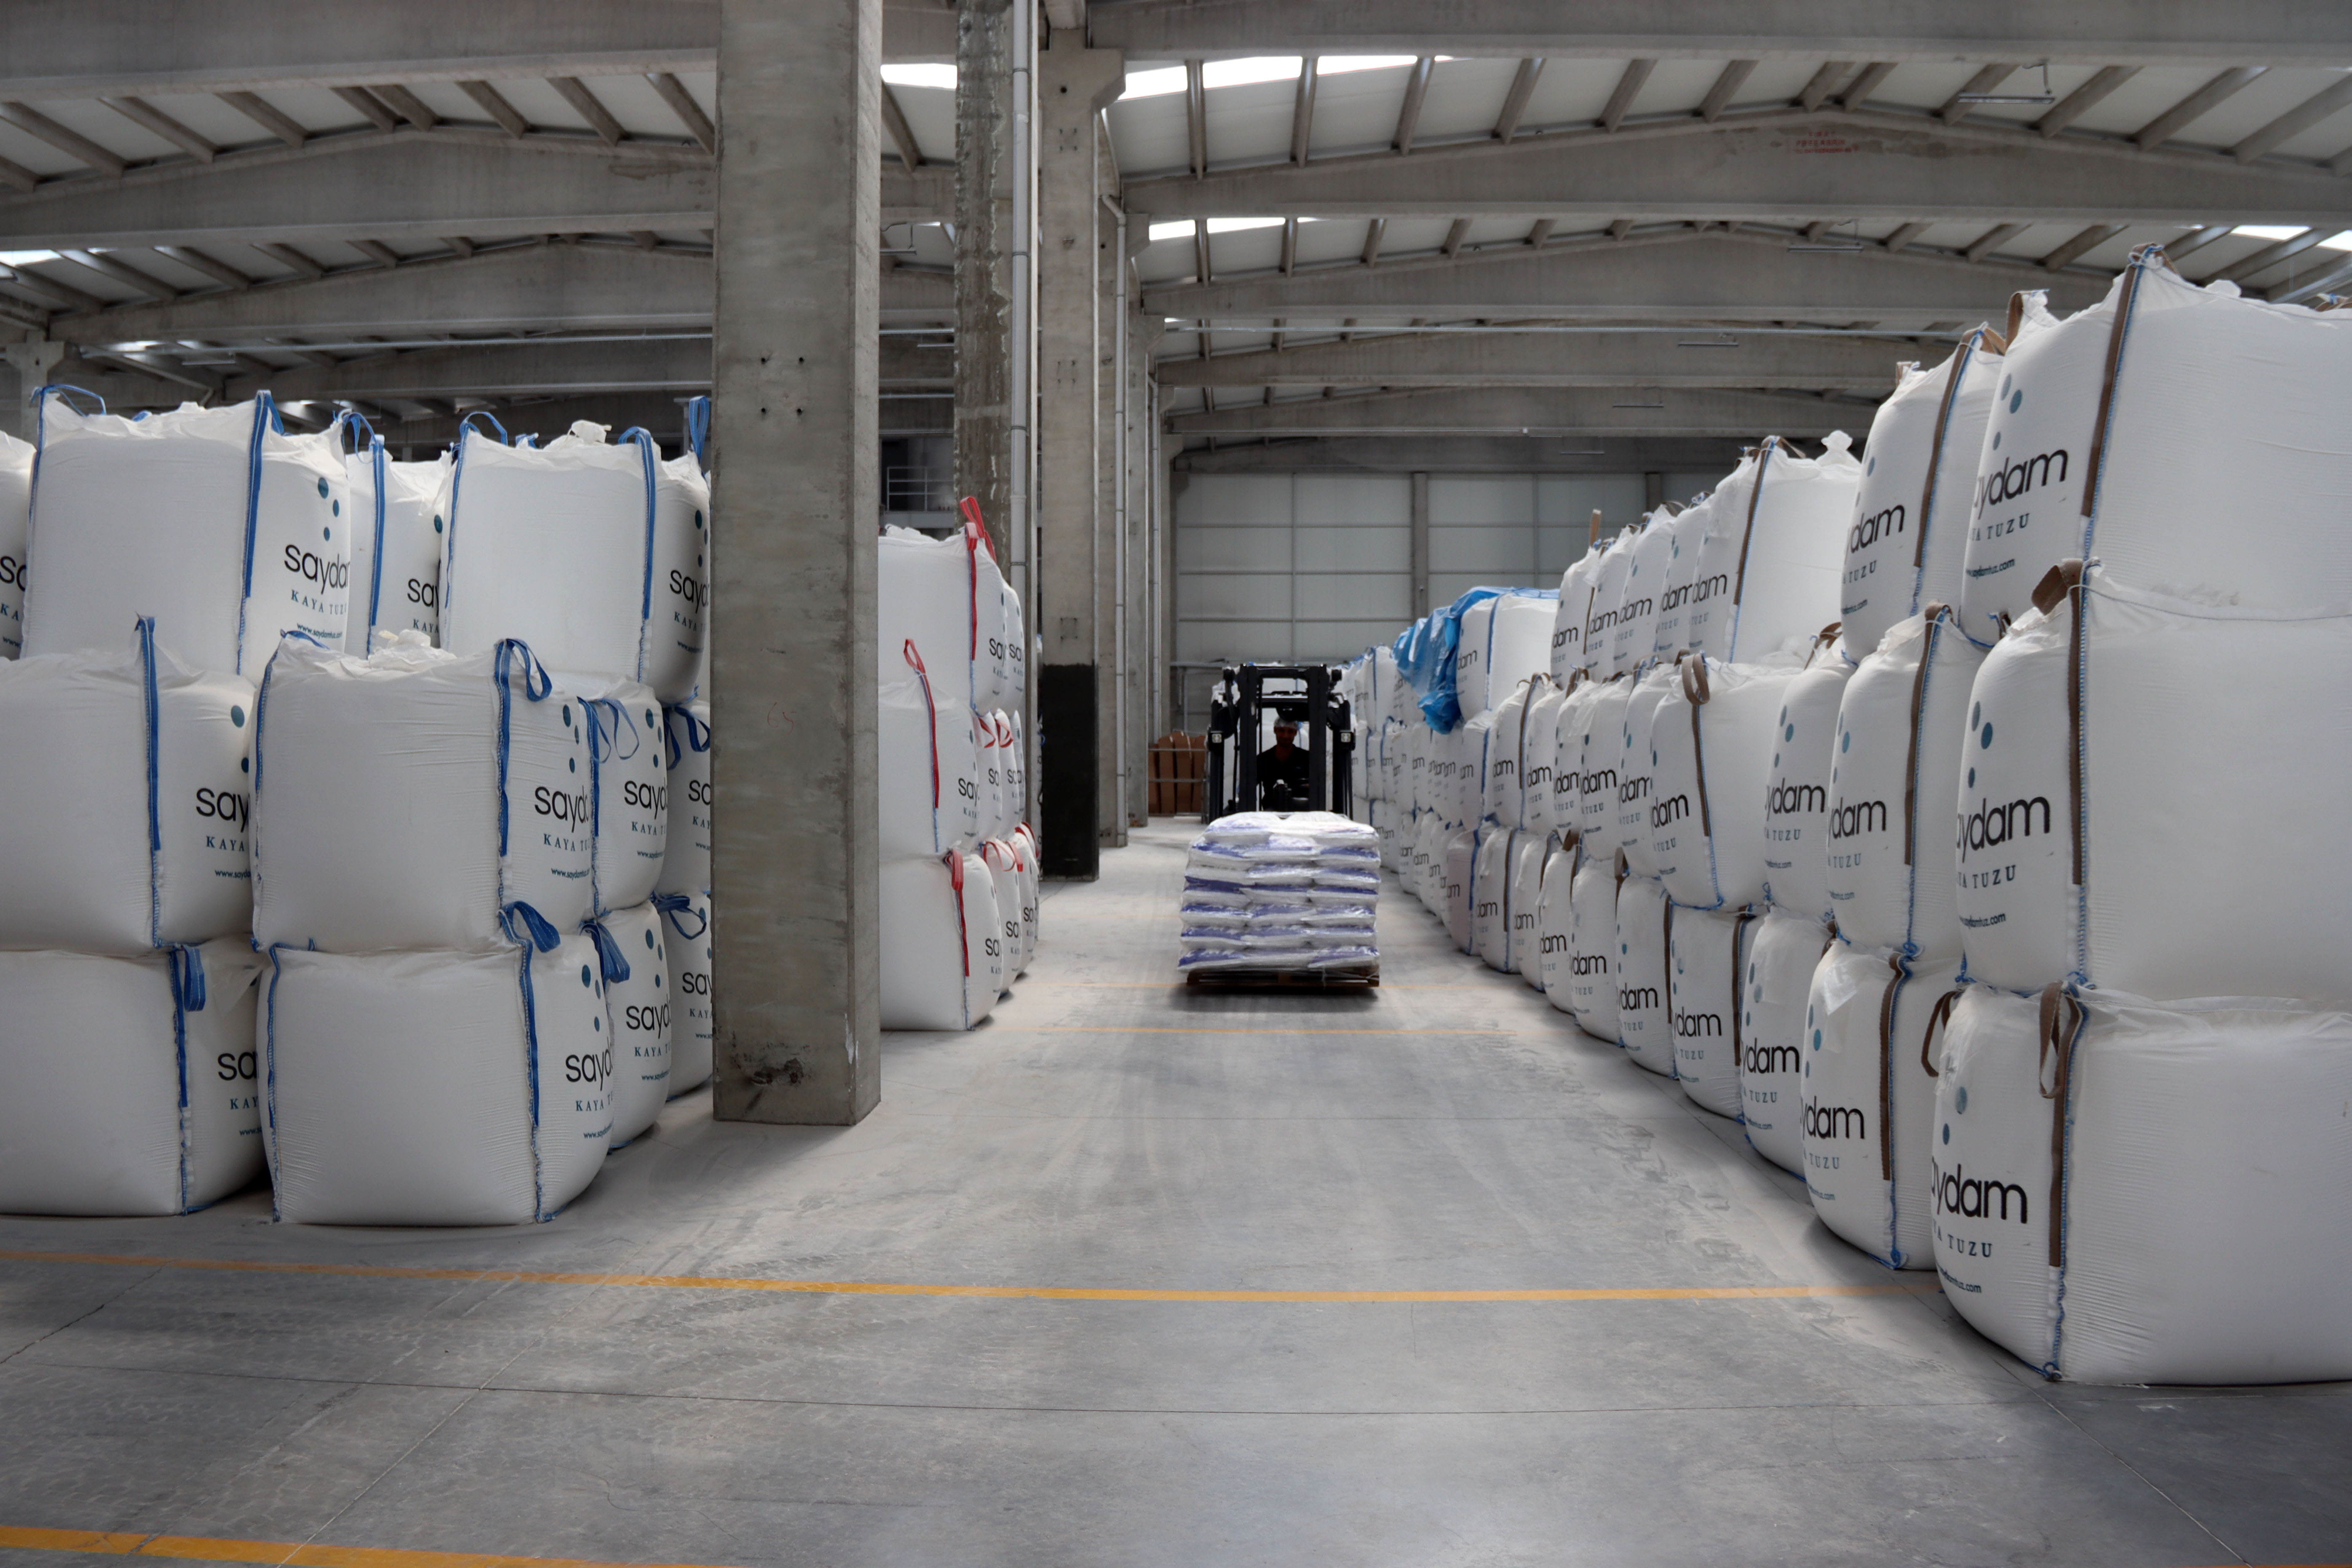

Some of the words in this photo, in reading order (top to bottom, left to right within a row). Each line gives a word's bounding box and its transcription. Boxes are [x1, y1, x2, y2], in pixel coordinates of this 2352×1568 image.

[1974, 449, 2068, 520] ydam
[1987, 513, 2030, 540] TUZU
[291, 589, 324, 613] KAYA
[407, 578, 439, 617] say
[670, 570, 709, 614] sayd
[1662, 584, 1693, 612] dam
[1692, 574, 1728, 604] dam
[0, 603, 19, 621] KA
[674, 612, 697, 631] KAYA
[1589, 611, 1617, 634] dam
[1619, 598, 1652, 624] dam
[413, 618, 439, 634] KAYA
[1552, 627, 1578, 648] dam
[1527, 765, 1552, 788] dam
[624, 777, 668, 820] sayd
[958, 778, 979, 807] say
[1766, 777, 1826, 821] ydam
[196, 788, 249, 833] say
[535, 785, 589, 833] sayd
[1651, 794, 1689, 829] dam
[632, 821, 657, 836] KAYA
[1773, 829, 1801, 841] TUZU
[1957, 796, 2050, 864] ydam
[206, 835, 244, 852] KAYA
[543, 833, 576, 852] KAYA
[1833, 853, 1862, 869] TUZU
[1972, 865, 2016, 889] TUZU
[1540, 931, 1567, 954] dam
[1572, 950, 1607, 976] dam
[626, 993, 671, 1039] sayd
[634, 1046, 661, 1057] KAYA
[1680, 1049, 1704, 1060] TUZU
[1743, 1038, 1800, 1077] ydam
[565, 1036, 613, 1092] sayd
[230, 1096, 258, 1110] KAY
[575, 1100, 604, 1111] KAYA
[1750, 1089, 1777, 1103] TUZU
[1801, 1095, 1865, 1140] ydam
[1809, 1152, 1840, 1169] TUZU
[1932, 1158, 2027, 1224] ydam
[1948, 1234, 1992, 1257] TUZU
